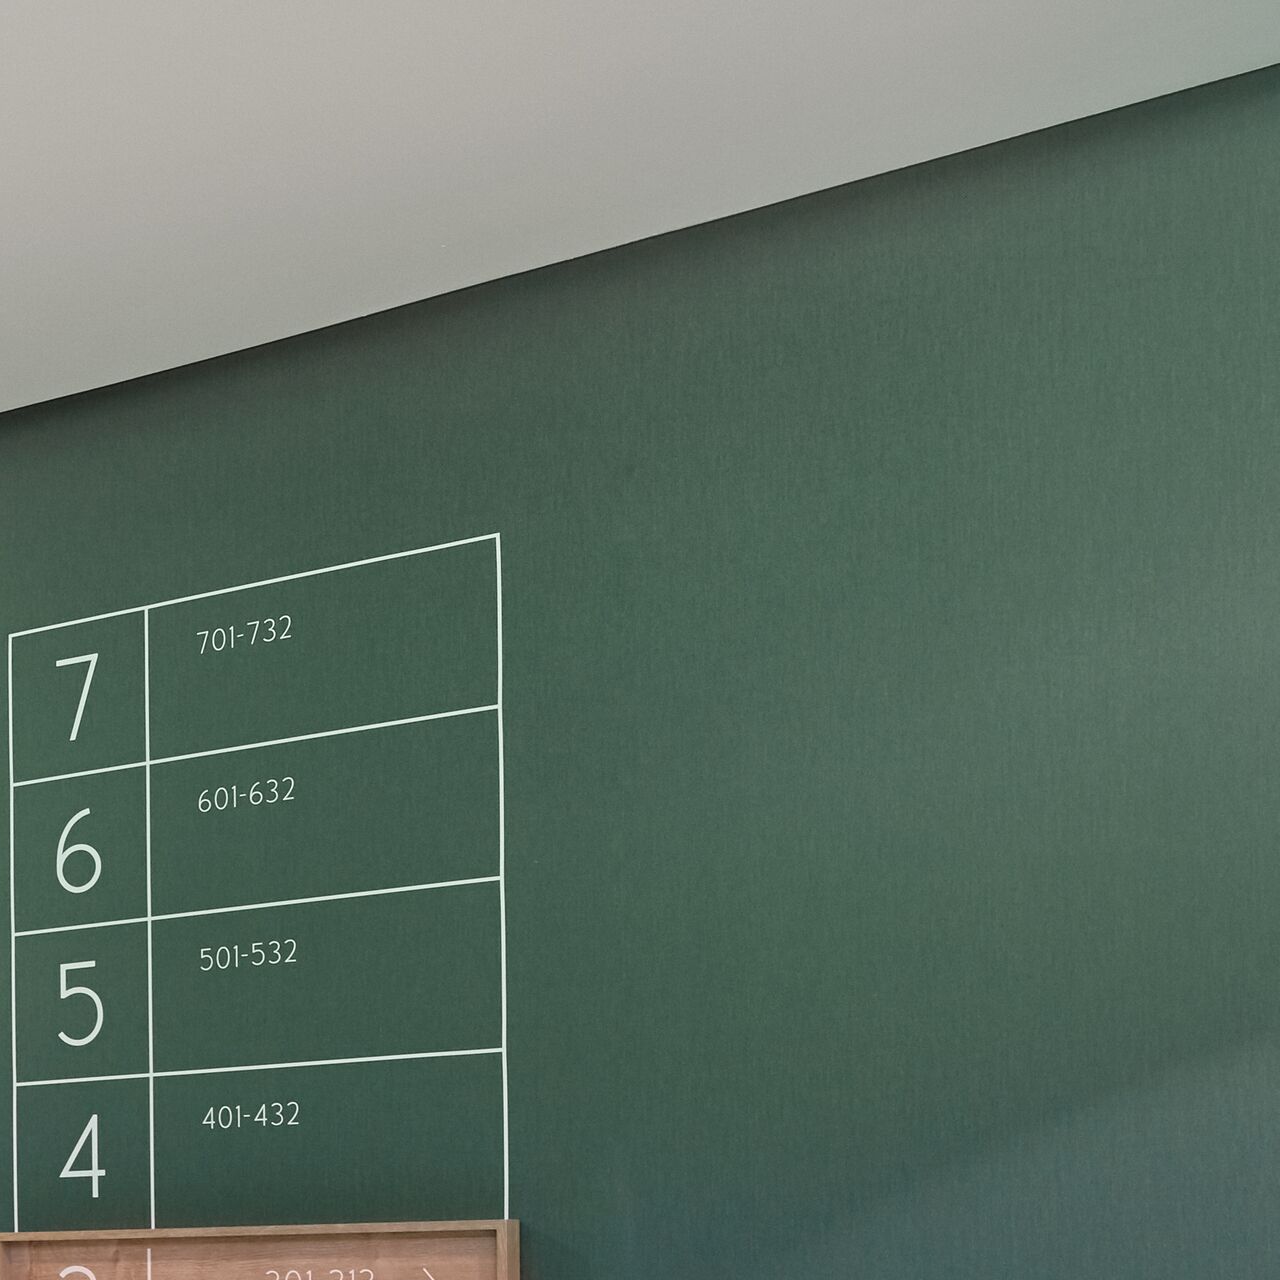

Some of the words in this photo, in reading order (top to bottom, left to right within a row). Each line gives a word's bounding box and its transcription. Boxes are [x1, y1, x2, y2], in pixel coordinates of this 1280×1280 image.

[197, 615, 292, 654] 701-732
[56, 653, 98, 741] 7
[198, 777, 295, 812] 601-632
[56, 808, 101, 893] 6
[200, 939, 297, 971] 501-532
[58, 961, 103, 1046] 5
[202, 1102, 300, 1129] 401-432
[59, 1114, 105, 1198] 4
